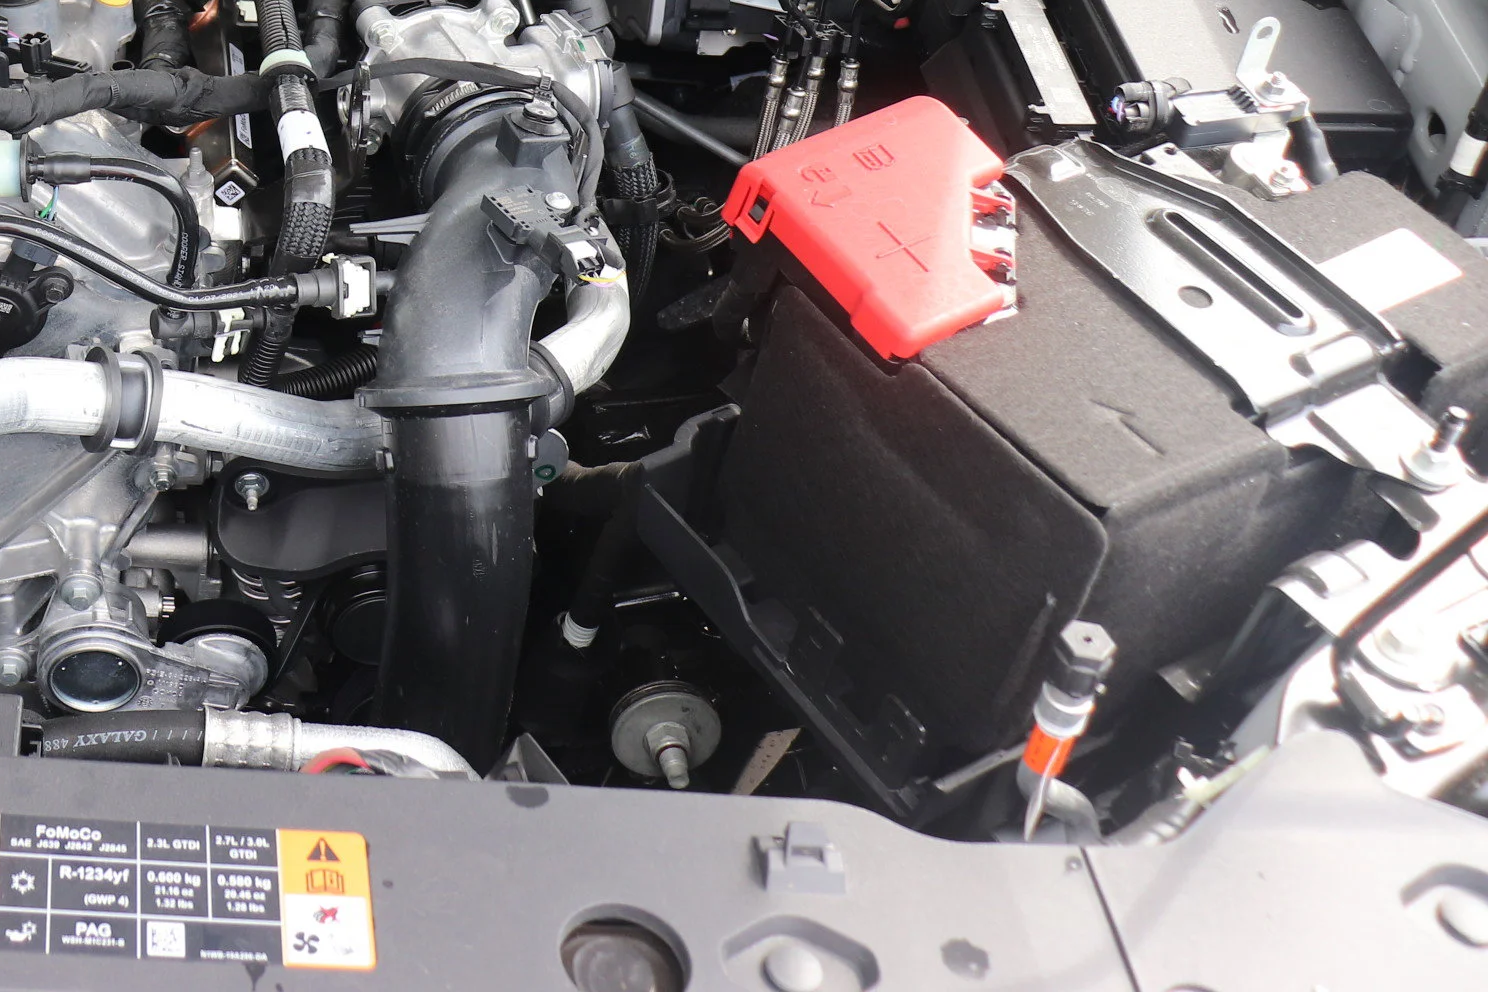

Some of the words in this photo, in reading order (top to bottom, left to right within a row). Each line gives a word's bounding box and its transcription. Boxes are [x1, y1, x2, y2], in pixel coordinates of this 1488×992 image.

[179, 231, 189, 261] COOPER
[73, 729, 147, 748] GALAXY
[35, 823, 102, 842] FoMoCo
[215, 834, 238, 846] 2.7L
[146, 837, 170, 849] 2.3L
[172, 838, 200, 850] GTDI
[59, 865, 130, 885] R-1234yf
[184, 872, 201, 888] kg
[254, 875, 272, 891] kg
[84, 893, 116, 906] (GWP
[118, 895, 130, 908] 4)
[75, 921, 112, 937] PAG
